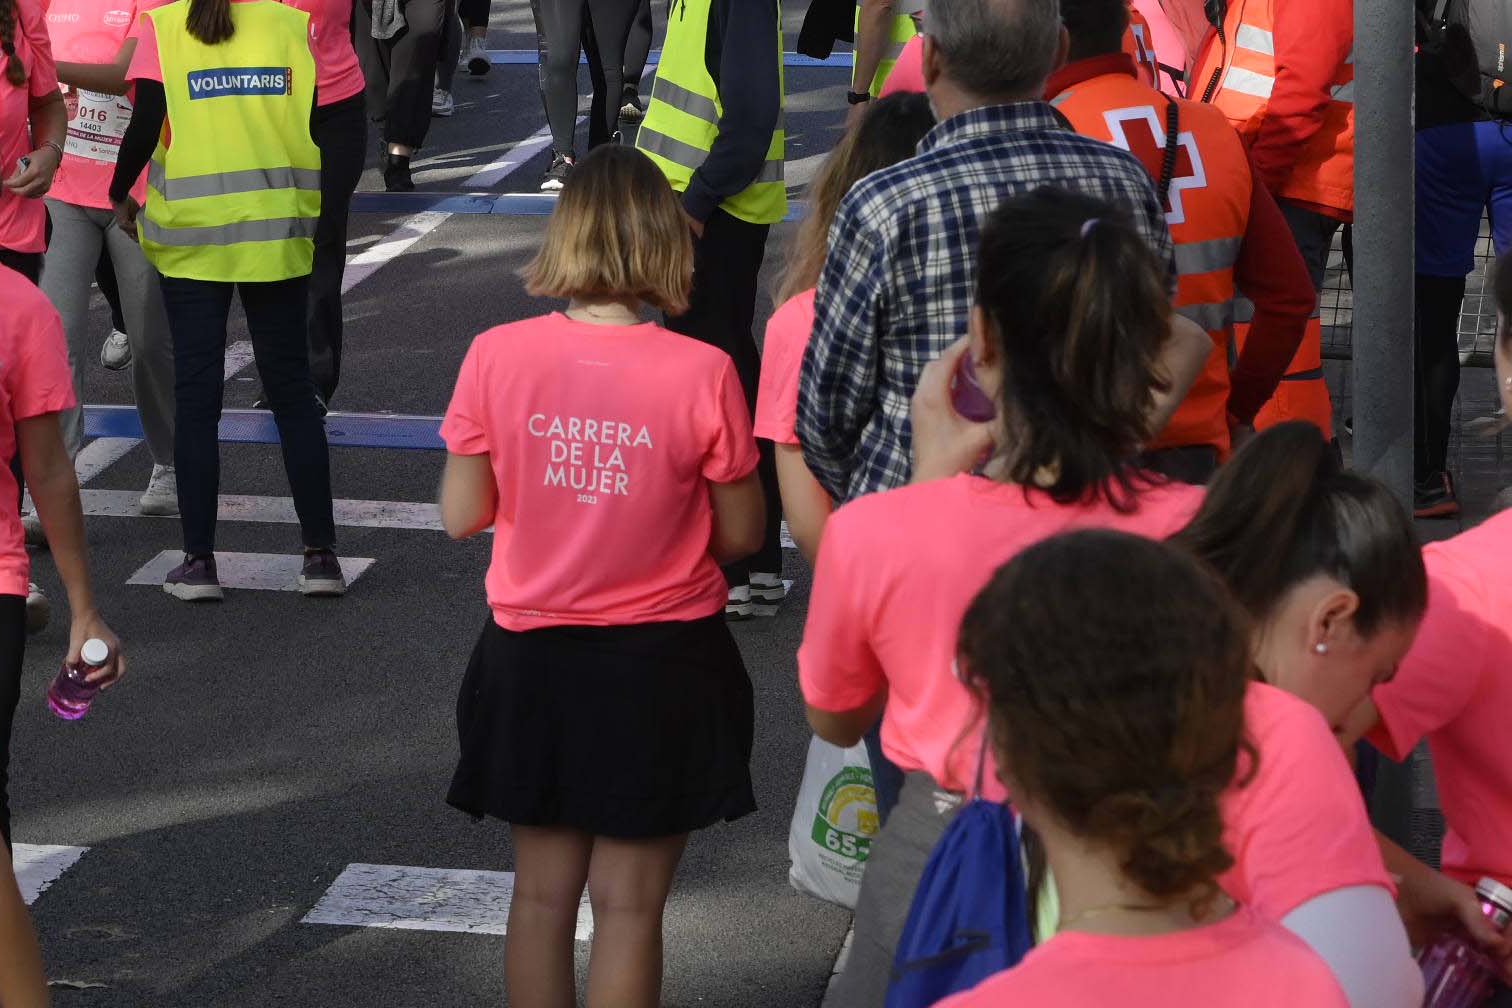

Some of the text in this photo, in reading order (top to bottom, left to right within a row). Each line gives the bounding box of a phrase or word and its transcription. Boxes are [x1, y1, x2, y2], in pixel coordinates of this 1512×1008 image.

[190, 71, 285, 93] VOLUNTARIS
[79, 106, 108, 122] 016
[80, 121, 102, 133] 14403
[528, 413, 654, 449] CARRERA
[550, 440, 626, 471] DE LA
[543, 462, 629, 496] MUJER
[576, 494, 598, 505] 2023
